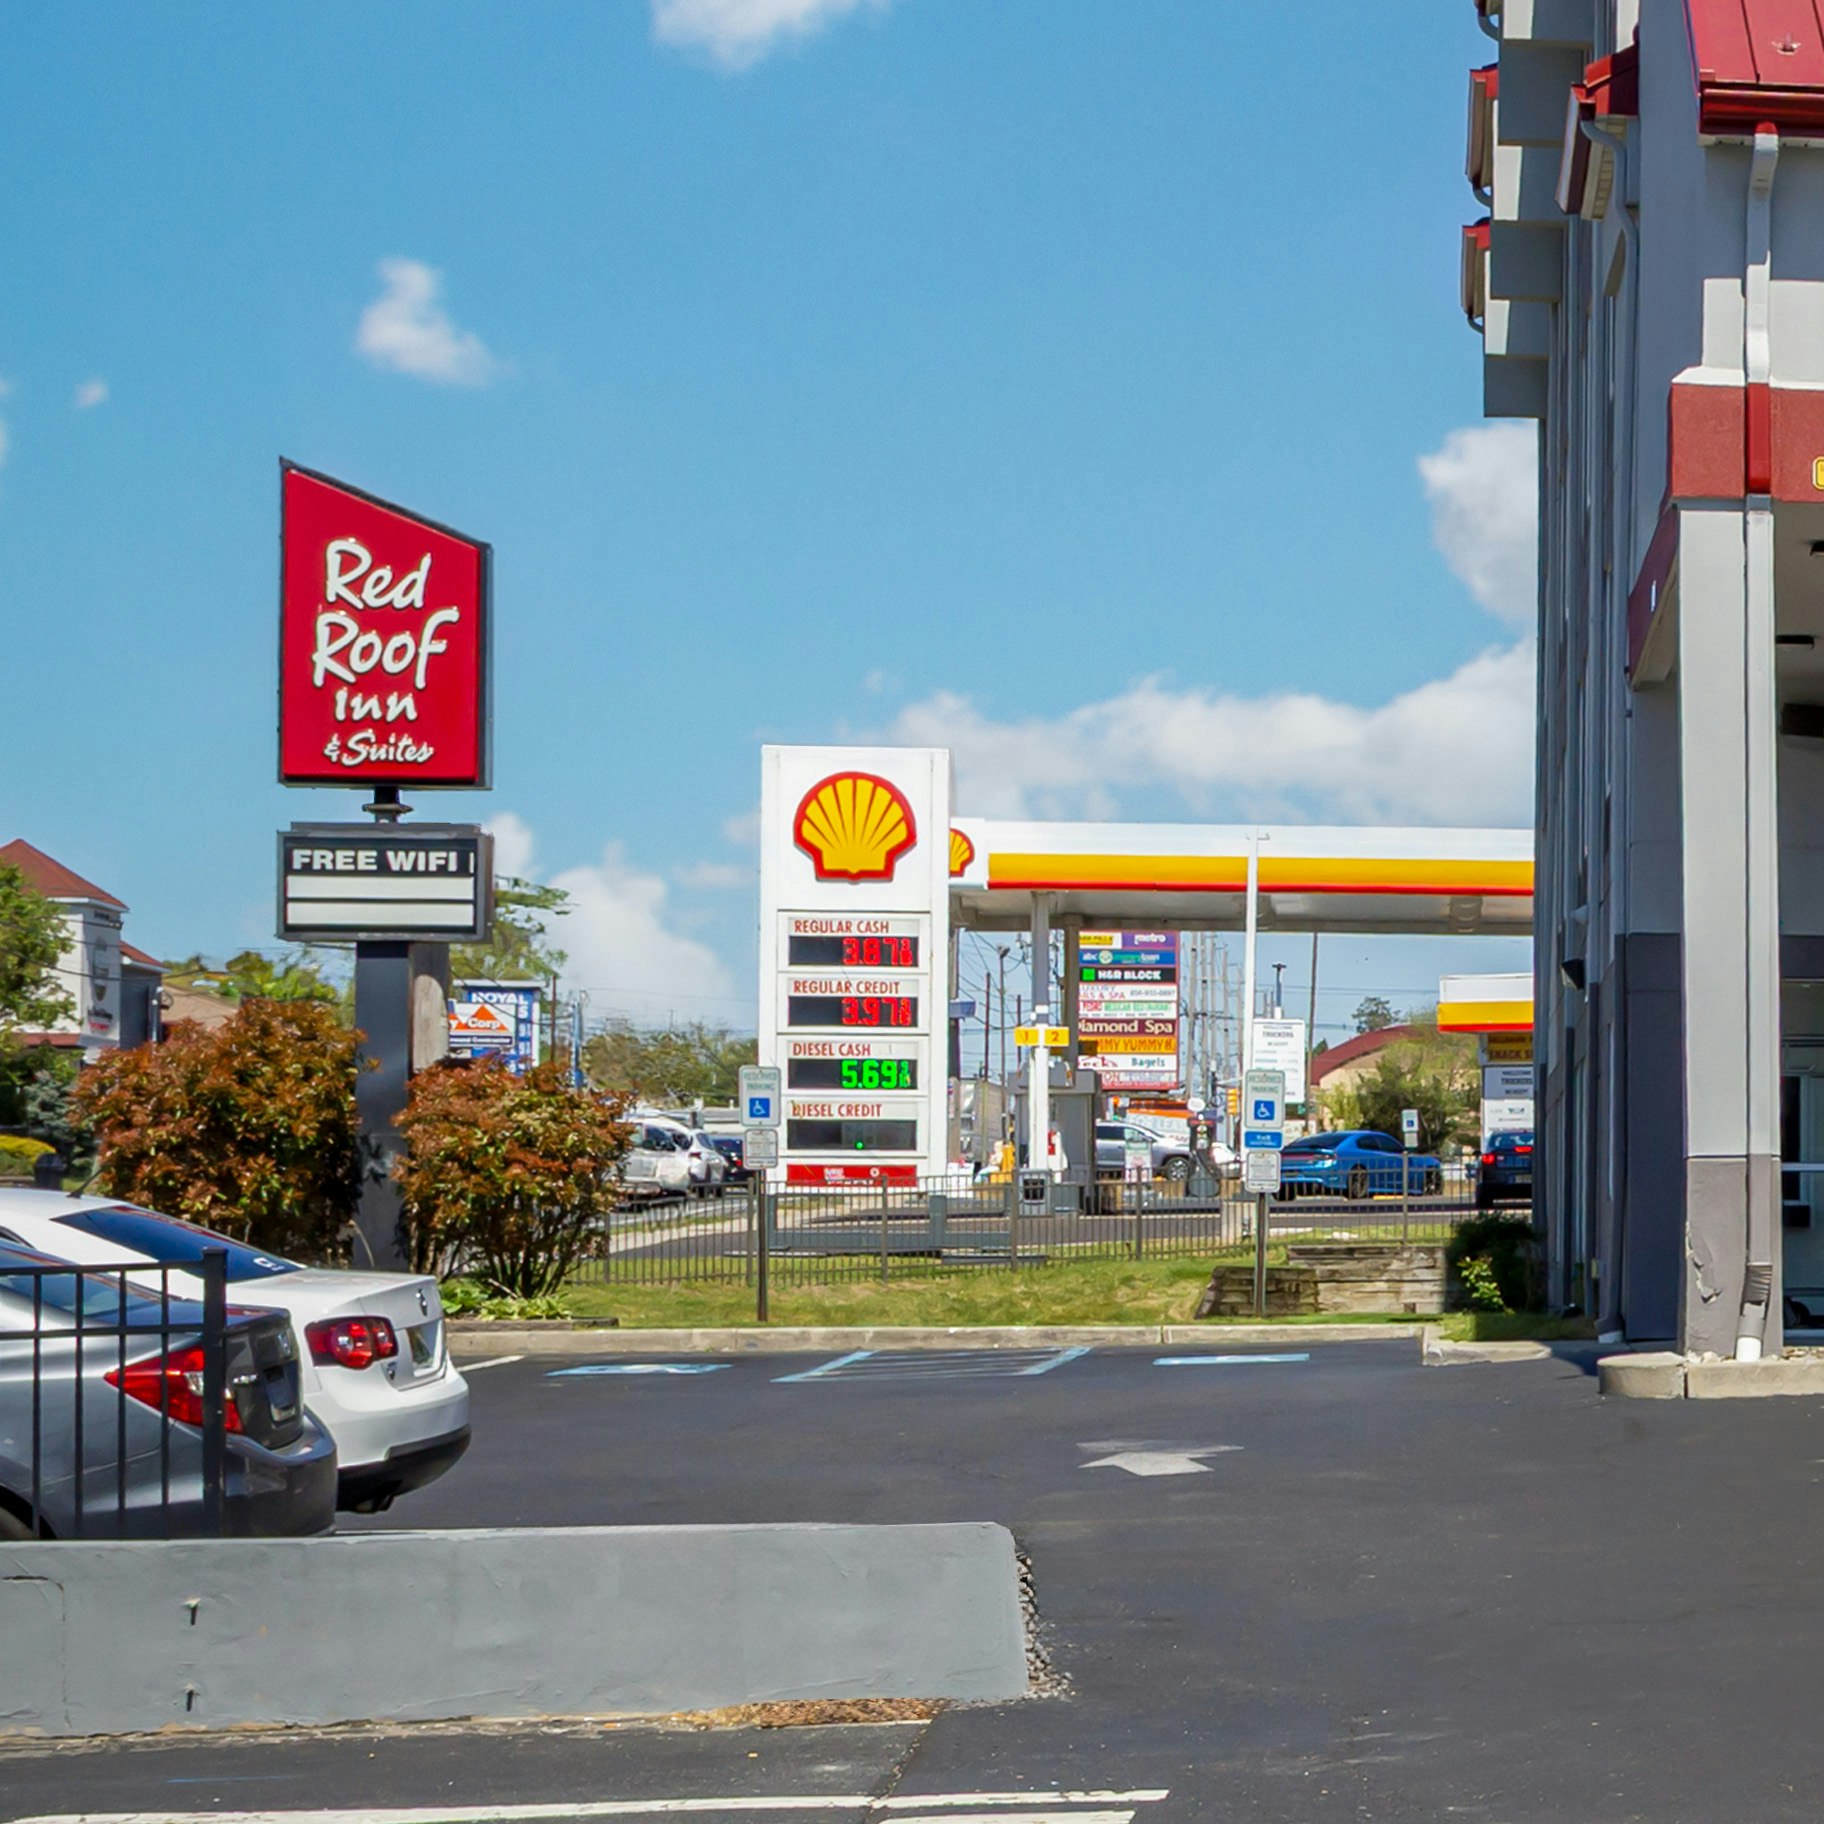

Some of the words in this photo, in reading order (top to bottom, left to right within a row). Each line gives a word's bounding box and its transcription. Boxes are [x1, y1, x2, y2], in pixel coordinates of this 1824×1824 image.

[325, 537, 432, 610] Red
[312, 606, 461, 690] Roof
[334, 687, 418, 722] Inn
[292, 848, 378, 872] FREE
[386, 849, 458, 873] WIFI
[793, 920, 852, 934] REGULAR
[856, 920, 890, 934] CASH
[1098, 970, 1122, 980] H&R
[1124, 970, 1161, 980] BLOCK
[793, 980, 853, 994] REGULAR
[856, 981, 900, 995] CREDIT
[470, 991, 528, 1005] ROYAL
[1079, 1019, 1139, 1033] iamond
[1144, 1019, 1174, 1035] Spa
[1024, 1030, 1029, 1042] 1
[1051, 1030, 1060, 1042] 2
[792, 1043, 835, 1057] DIESEL
[838, 1043, 872, 1057] CASH
[1123, 1039, 1165, 1052] YUMMY
[1131, 1057, 1166, 1068] Bagels
[791, 1103, 834, 1118] DIESEL
[837, 1103, 882, 1118] CREDIT
